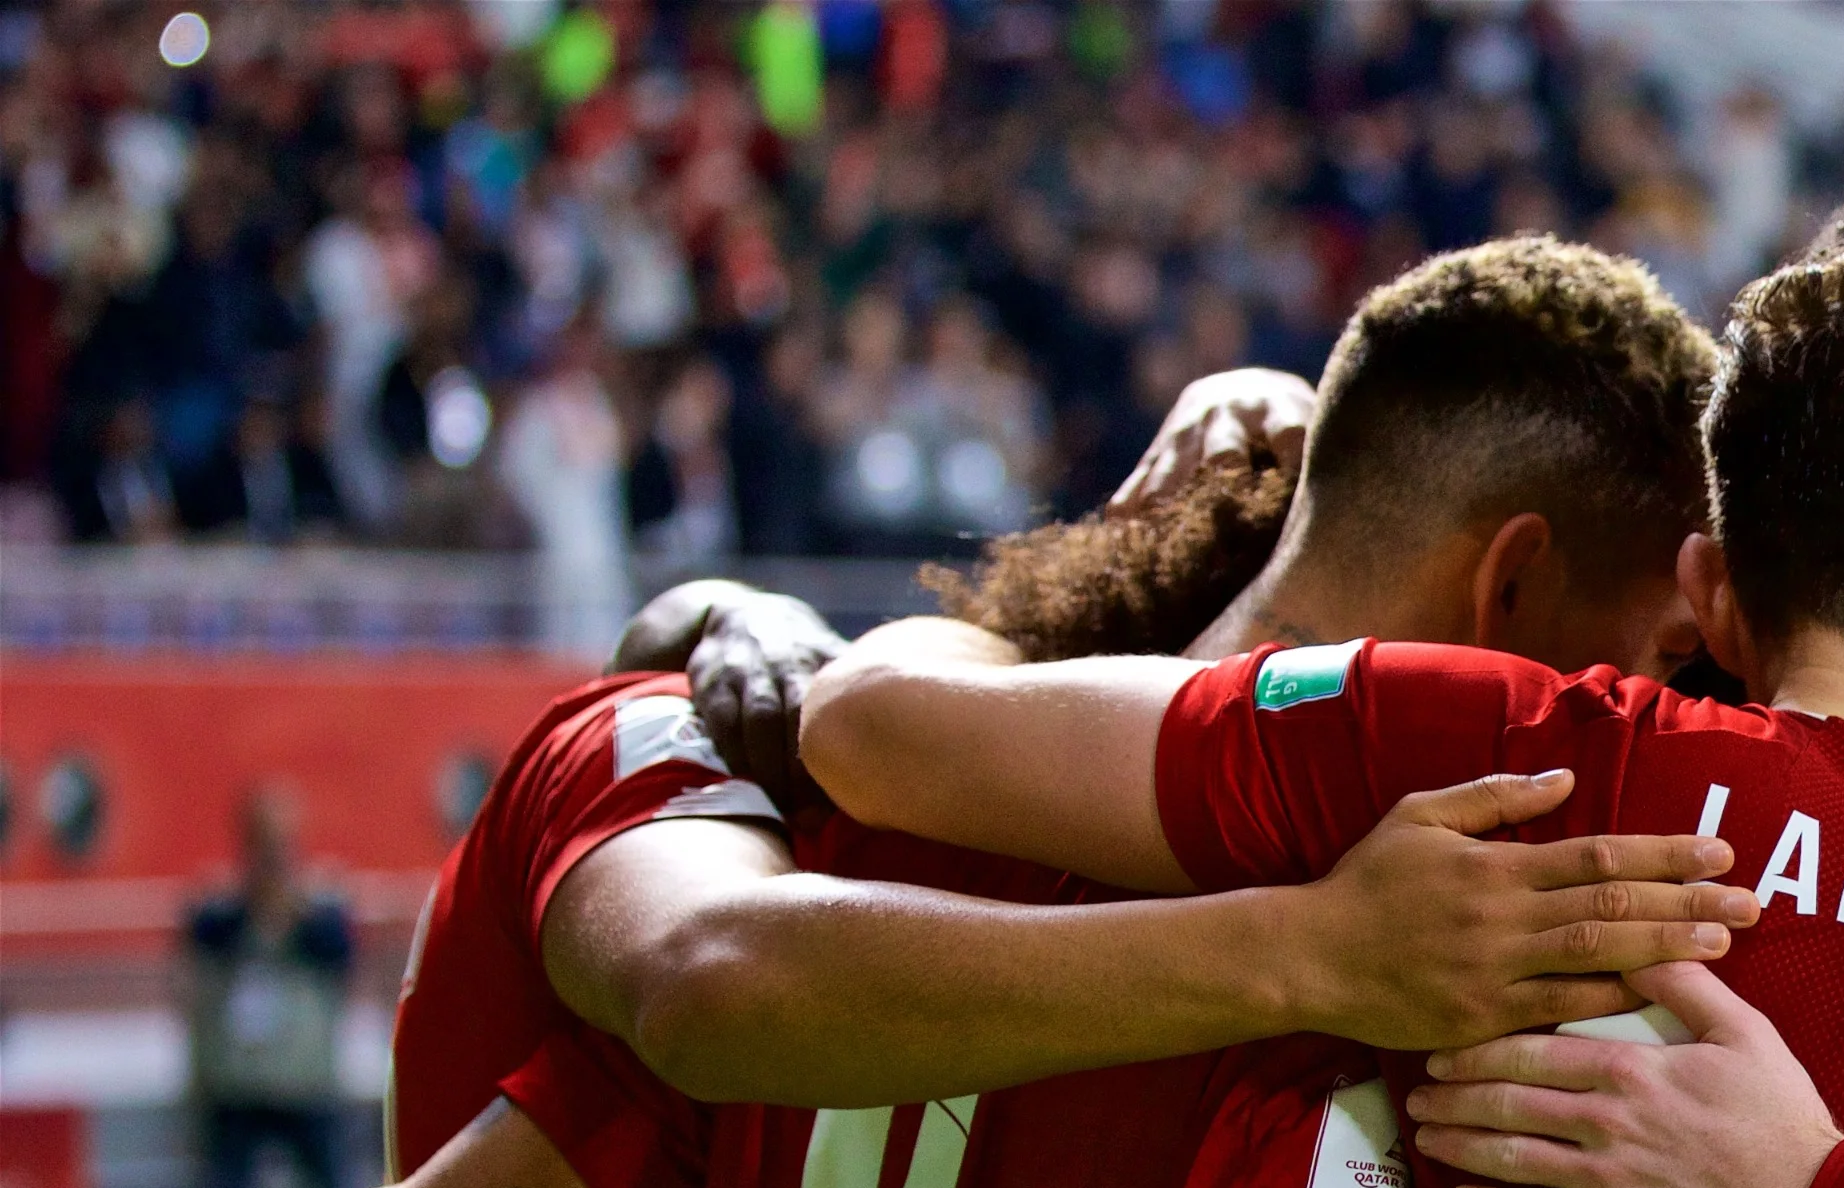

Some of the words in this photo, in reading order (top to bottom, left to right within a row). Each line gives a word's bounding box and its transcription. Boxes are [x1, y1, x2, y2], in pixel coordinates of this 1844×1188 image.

[1345, 1160, 1376, 1172] CLUB
[1377, 1164, 1407, 1180] WOR
[1354, 1172, 1400, 1188] QATAR
